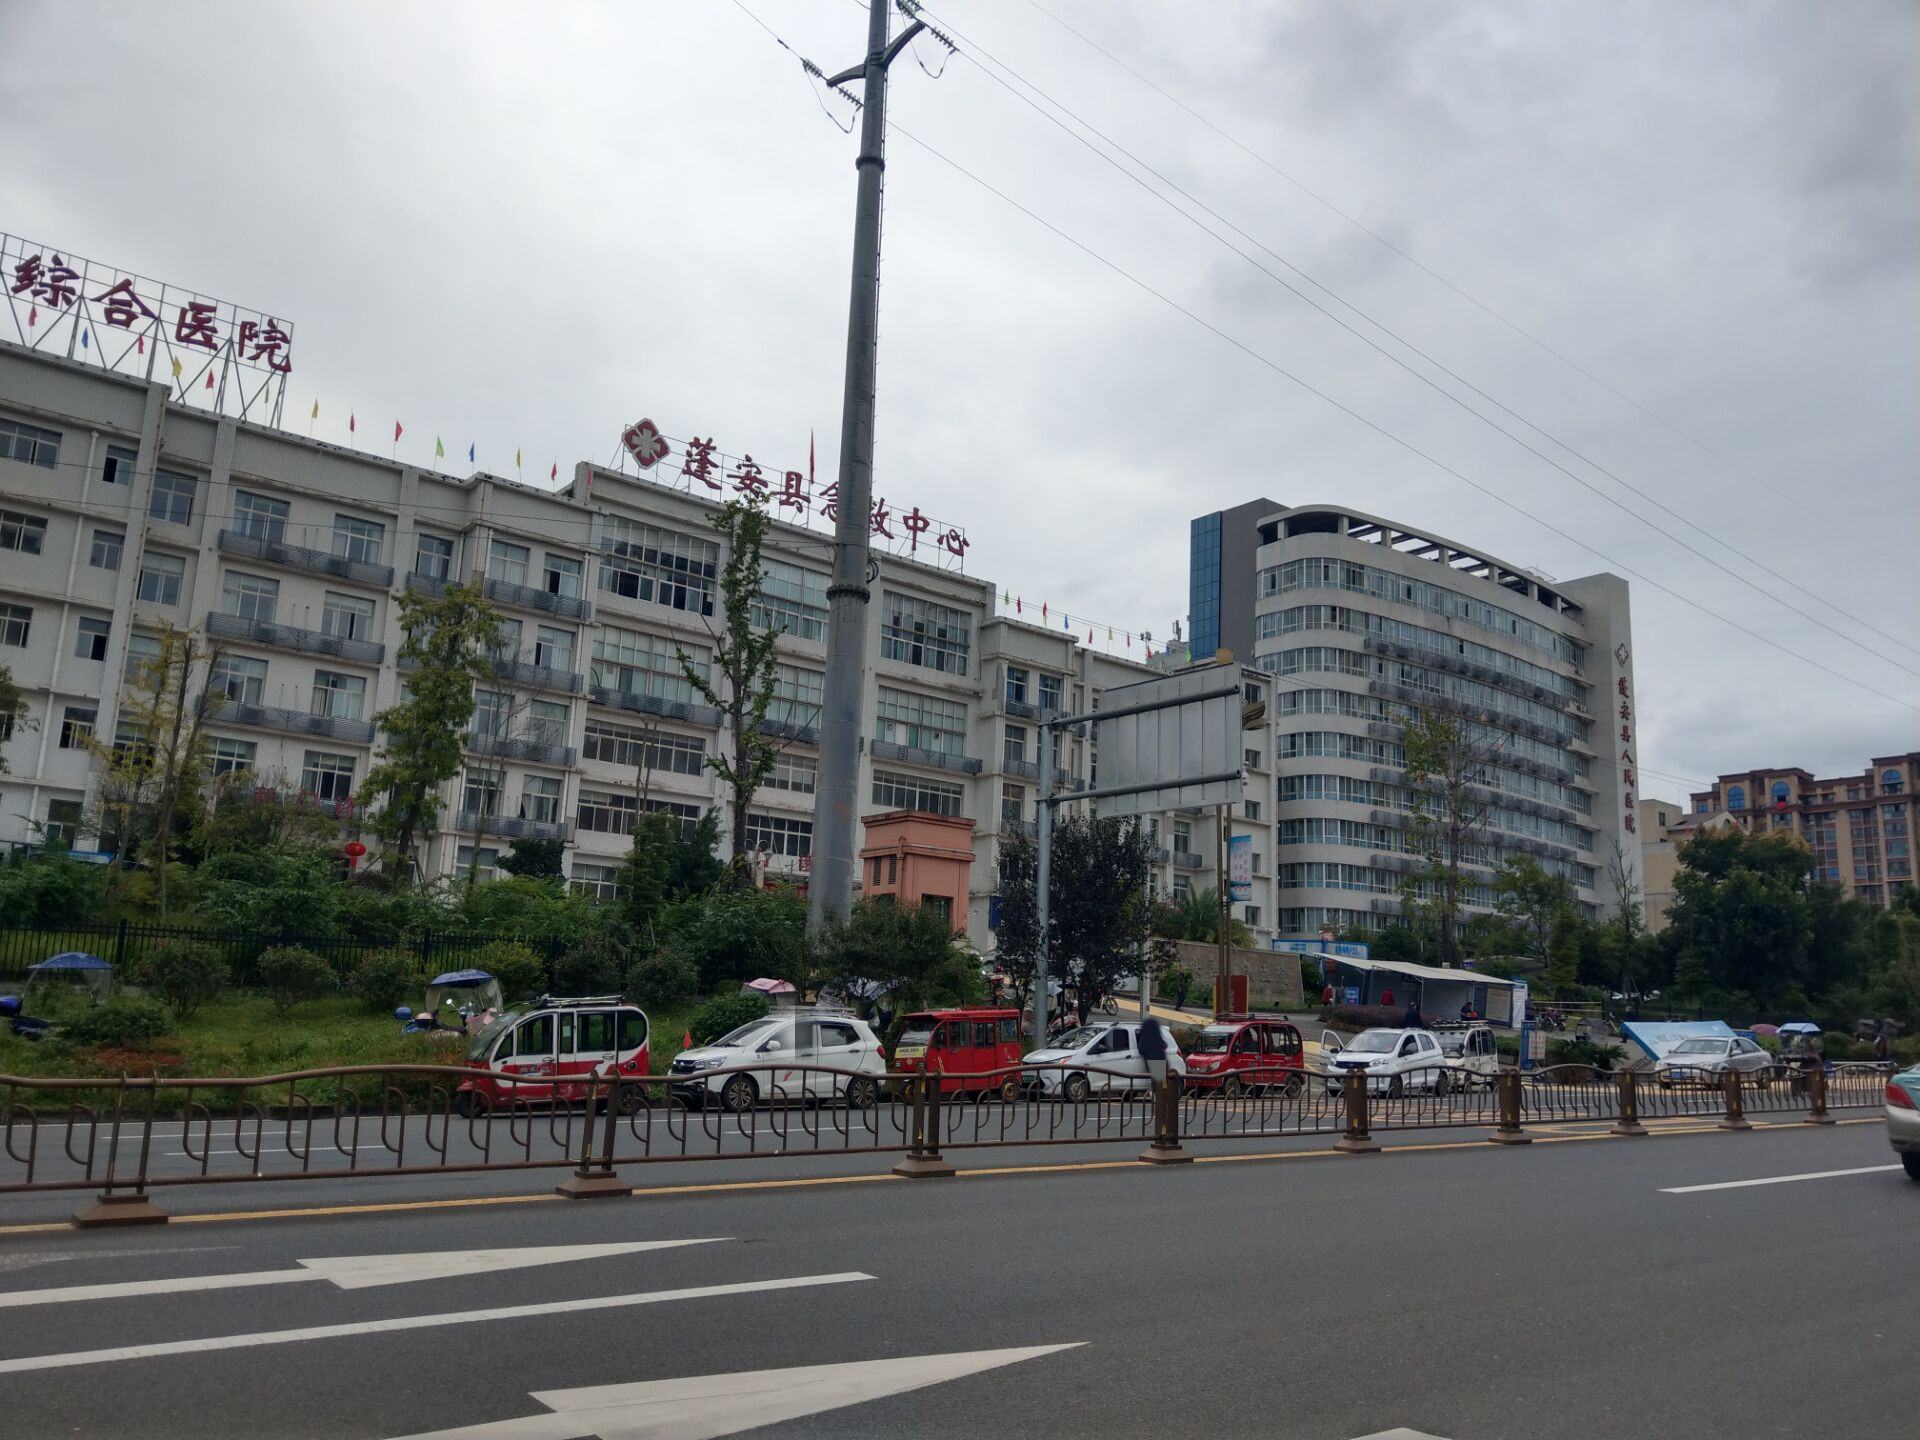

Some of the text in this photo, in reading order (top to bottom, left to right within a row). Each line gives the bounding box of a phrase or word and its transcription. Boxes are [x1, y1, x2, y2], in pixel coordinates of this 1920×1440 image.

[11, 253, 292, 373] 综合医院
[1617, 676, 1636, 834] 蓬安县人民医院
